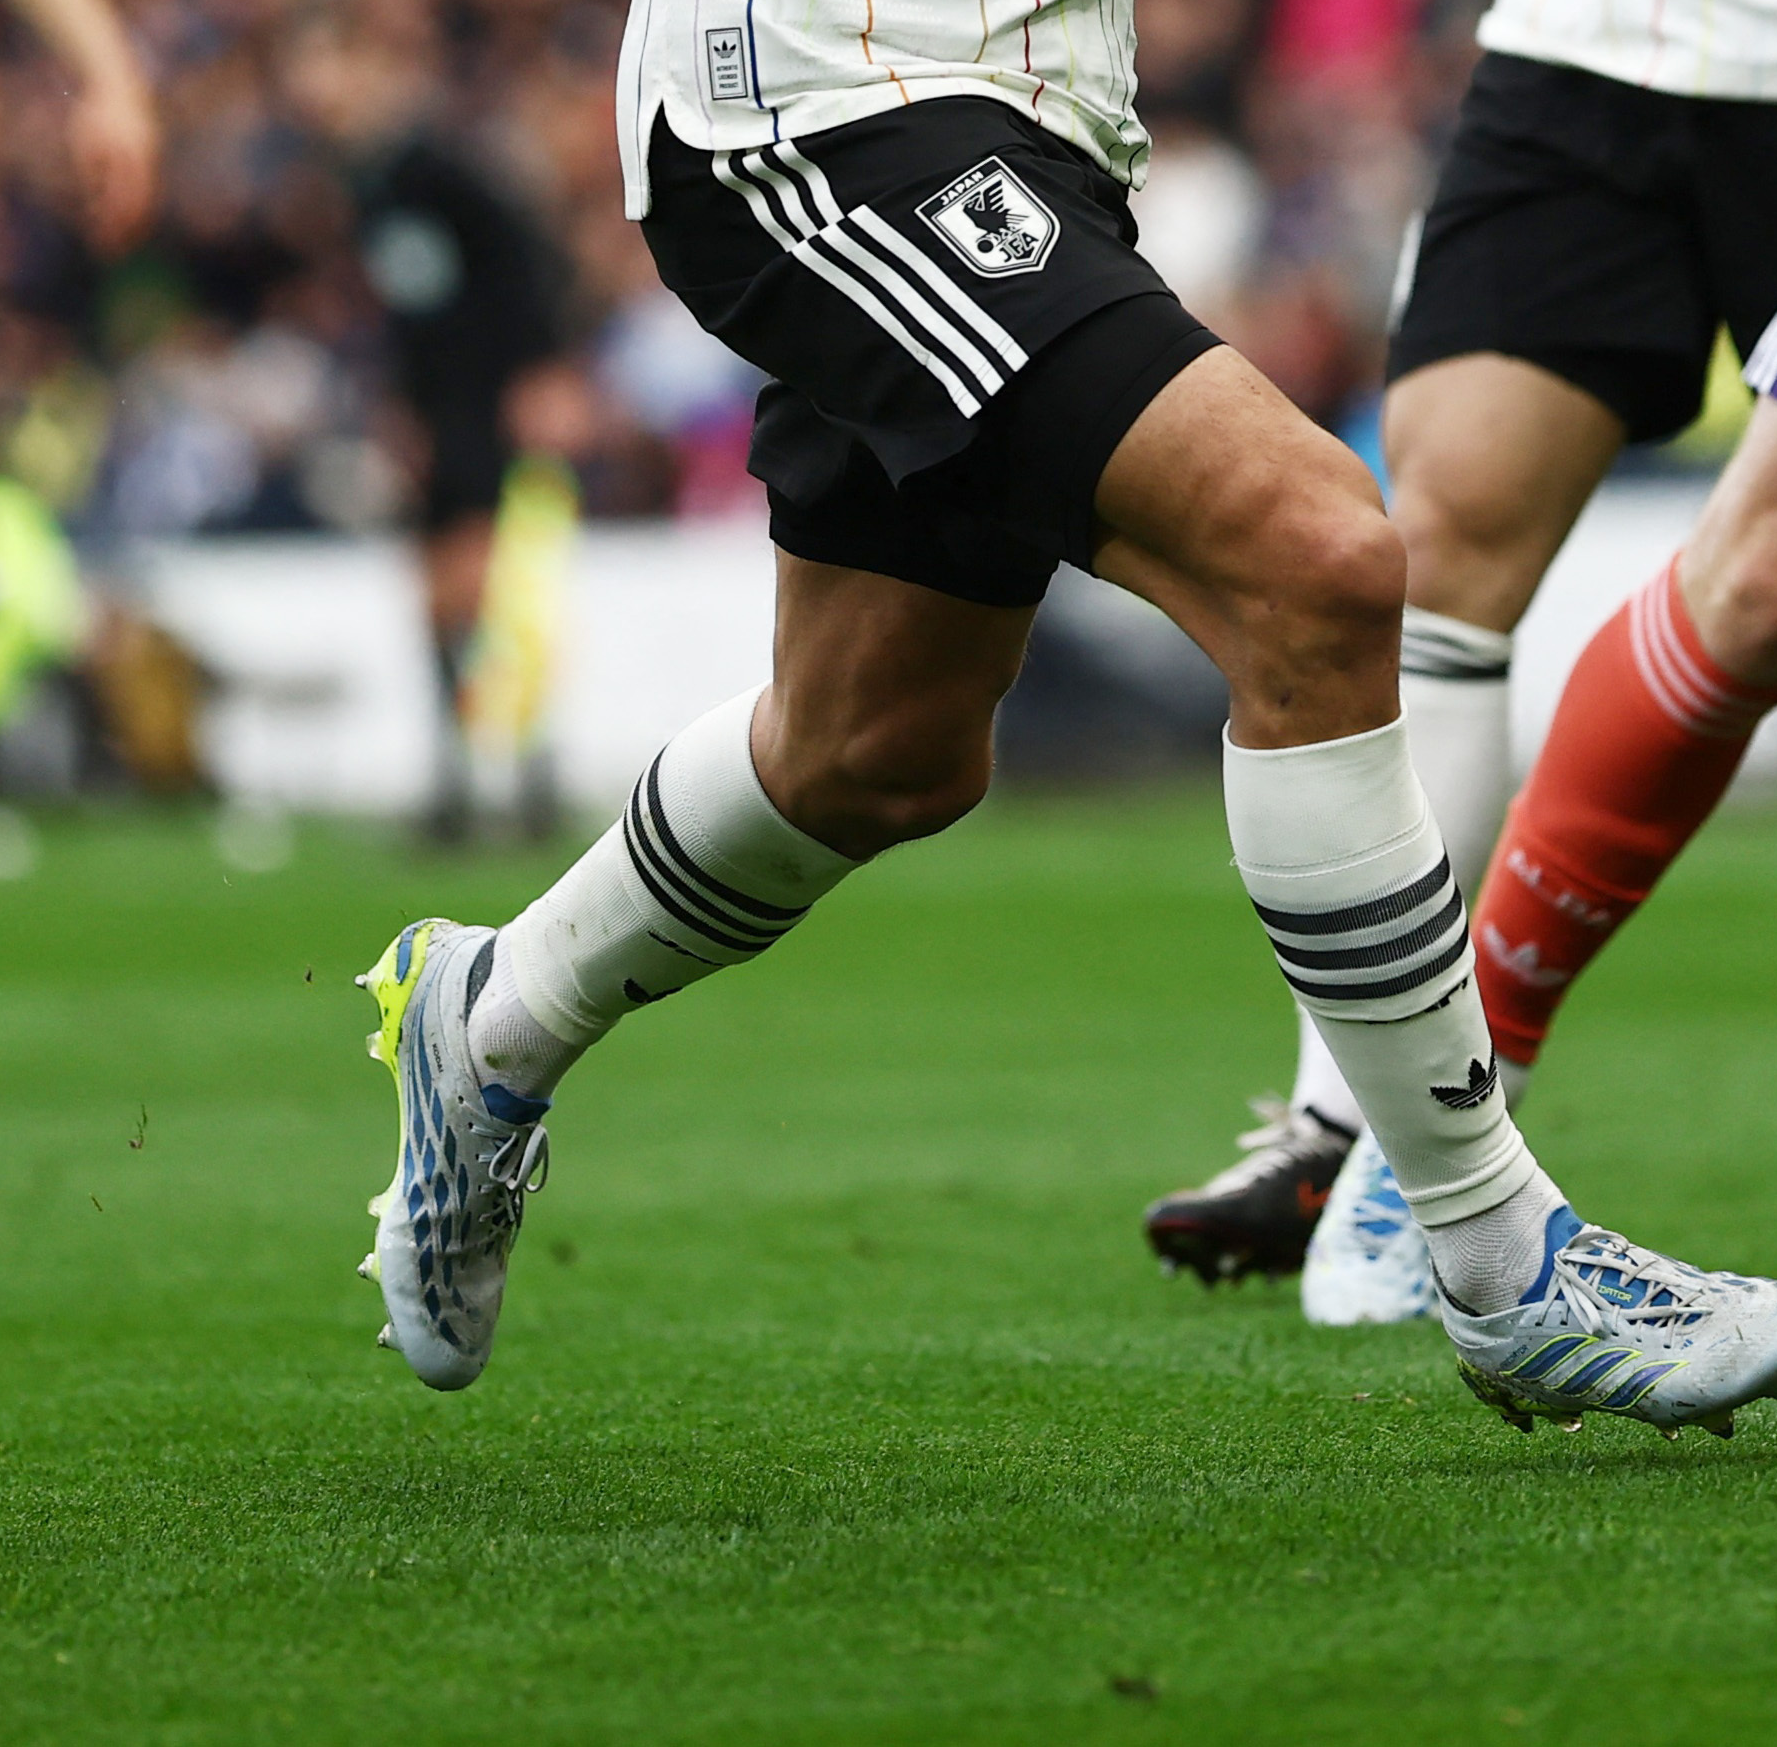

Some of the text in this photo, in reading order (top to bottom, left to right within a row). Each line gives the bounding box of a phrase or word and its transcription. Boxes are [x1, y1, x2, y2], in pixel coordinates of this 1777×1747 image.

[940, 171, 984, 206] JAPAN
[999, 232, 1039, 263] JFA
[1597, 1284, 1633, 1303] DATOR
